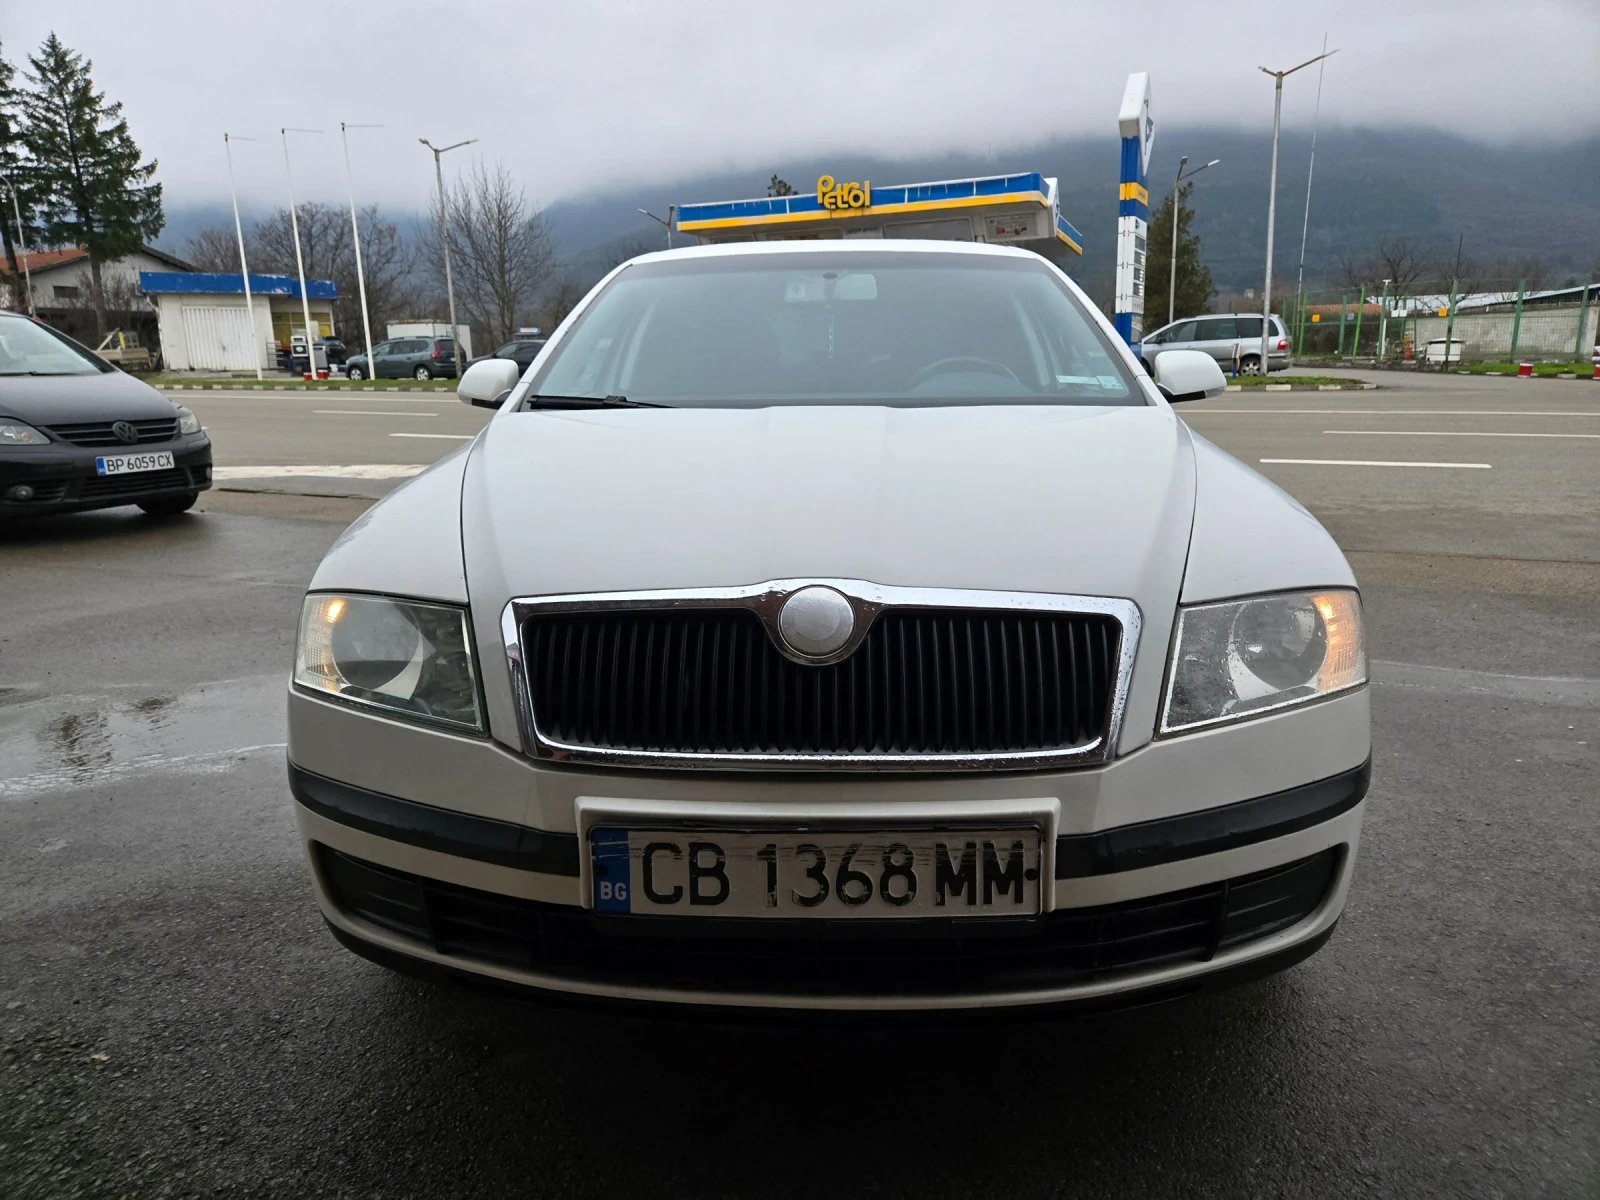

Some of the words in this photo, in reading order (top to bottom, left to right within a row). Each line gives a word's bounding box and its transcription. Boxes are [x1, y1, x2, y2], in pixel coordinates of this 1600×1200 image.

[817, 174, 871, 210] Petrol
[106, 458, 124, 472] BP
[127, 456, 156, 470] 6059
[157, 454, 173, 467] CX
[642, 841, 731, 906] CB
[757, 842, 918, 908] 1368
[935, 840, 1024, 906] MM
[600, 881, 627, 900] BG
